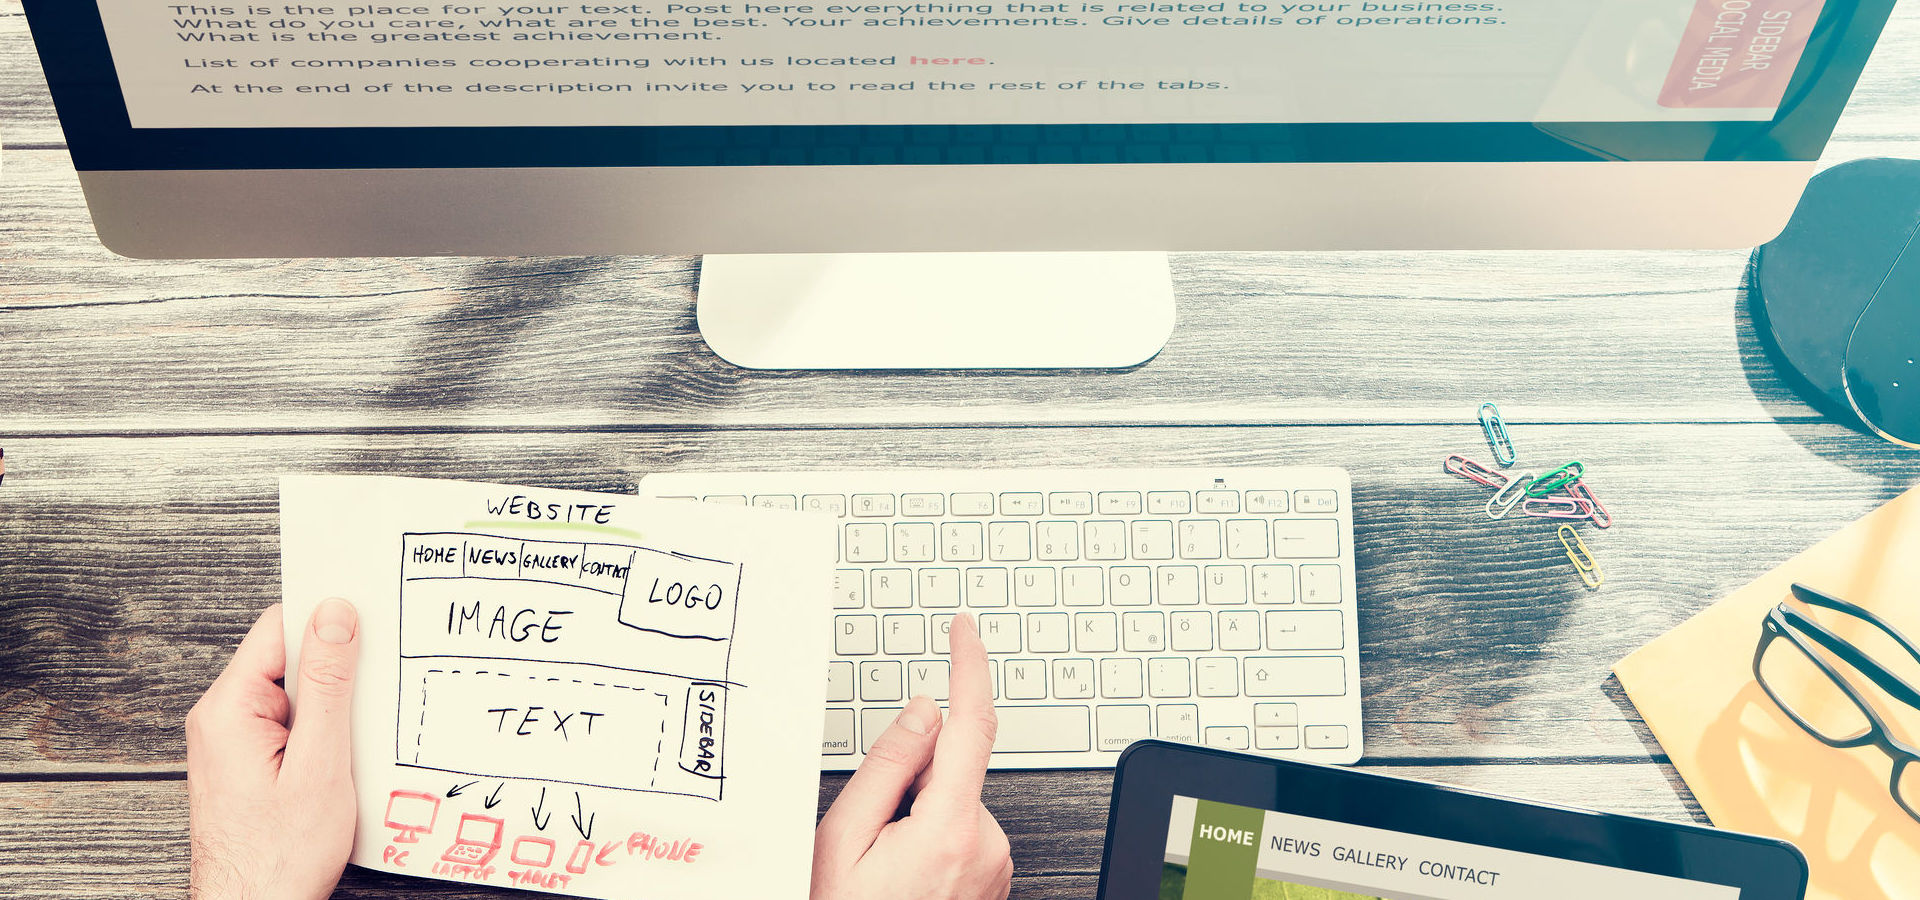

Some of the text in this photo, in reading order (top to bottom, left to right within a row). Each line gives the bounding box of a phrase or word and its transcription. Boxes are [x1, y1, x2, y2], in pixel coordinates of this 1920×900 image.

[167, 1, 1503, 17] This is the place for your text. Post here everything that is related to your business.
[172, 13, 1507, 31] What do you care, what are the best. Your achievements. Give details of operations.
[176, 29, 722, 44] What is the greatest achievement.
[1739, 10, 1792, 72] SIDEBAR
[1688, 0, 1752, 92] OCIAL MEDIA
[183, 55, 995, 70] List of companies cooperating with us located here.
[190, 79, 1229, 95] At the end of the description invite you to read the rest of the tabs.
[878, 501, 893, 512] F4
[927, 501, 942, 512] F5
[977, 500, 992, 511] F6
[1027, 500, 1039, 511] F7
[1074, 499, 1088, 510] F8
[1125, 499, 1138, 509] F9
[1169, 498, 1188, 509] F10
[1220, 498, 1236, 509] F11
[1266, 498, 1285, 509] F12
[1317, 495, 1333, 507] Del
[487, 495, 616, 524] WEBSITE
[412, 542, 458, 564] HOME
[468, 546, 518, 565] NEWS
[852, 545, 860, 556] 4
[901, 544, 909, 557] 5
[951, 544, 958, 556] 6
[997, 544, 1005, 556] 7
[1045, 543, 1053, 555] 8
[1093, 543, 1101, 555] 9
[1141, 543, 1149, 554] 0
[522, 552, 580, 570] GALLERY
[880, 575, 890, 589] R
[926, 575, 937, 588] T
[975, 574, 985, 588] Z
[1024, 573, 1035, 588] U
[1118, 573, 1131, 587] O
[1167, 572, 1175, 586] P
[1212, 571, 1224, 587] Ü
[648, 578, 723, 610] LOGO
[447, 600, 575, 643] IMAGE
[892, 621, 900, 636] F
[940, 621, 950, 635] G
[989, 620, 999, 634] H
[1085, 619, 1095, 633] K
[1132, 619, 1141, 633] L
[1180, 618, 1191, 632] Ö
[1228, 618, 1238, 632] Ä
[844, 622, 855, 636] D
[870, 668, 880, 682] C
[917, 667, 928, 681] V
[1015, 666, 1025, 681] N
[1062, 666, 1076, 680] M
[487, 706, 606, 741] TEXT
[1180, 712, 1191, 721] alt
[693, 688, 717, 773] SIDEBAR
[822, 738, 848, 748] mand
[1104, 737, 1134, 746] comm
[625, 832, 705, 864] PHONE
[1198, 823, 1500, 887] HOME NEWS GALLERY CONTACT
[383, 844, 411, 867] PC
[431, 861, 497, 881] LAPTOP
[507, 868, 573, 889] TABLET
